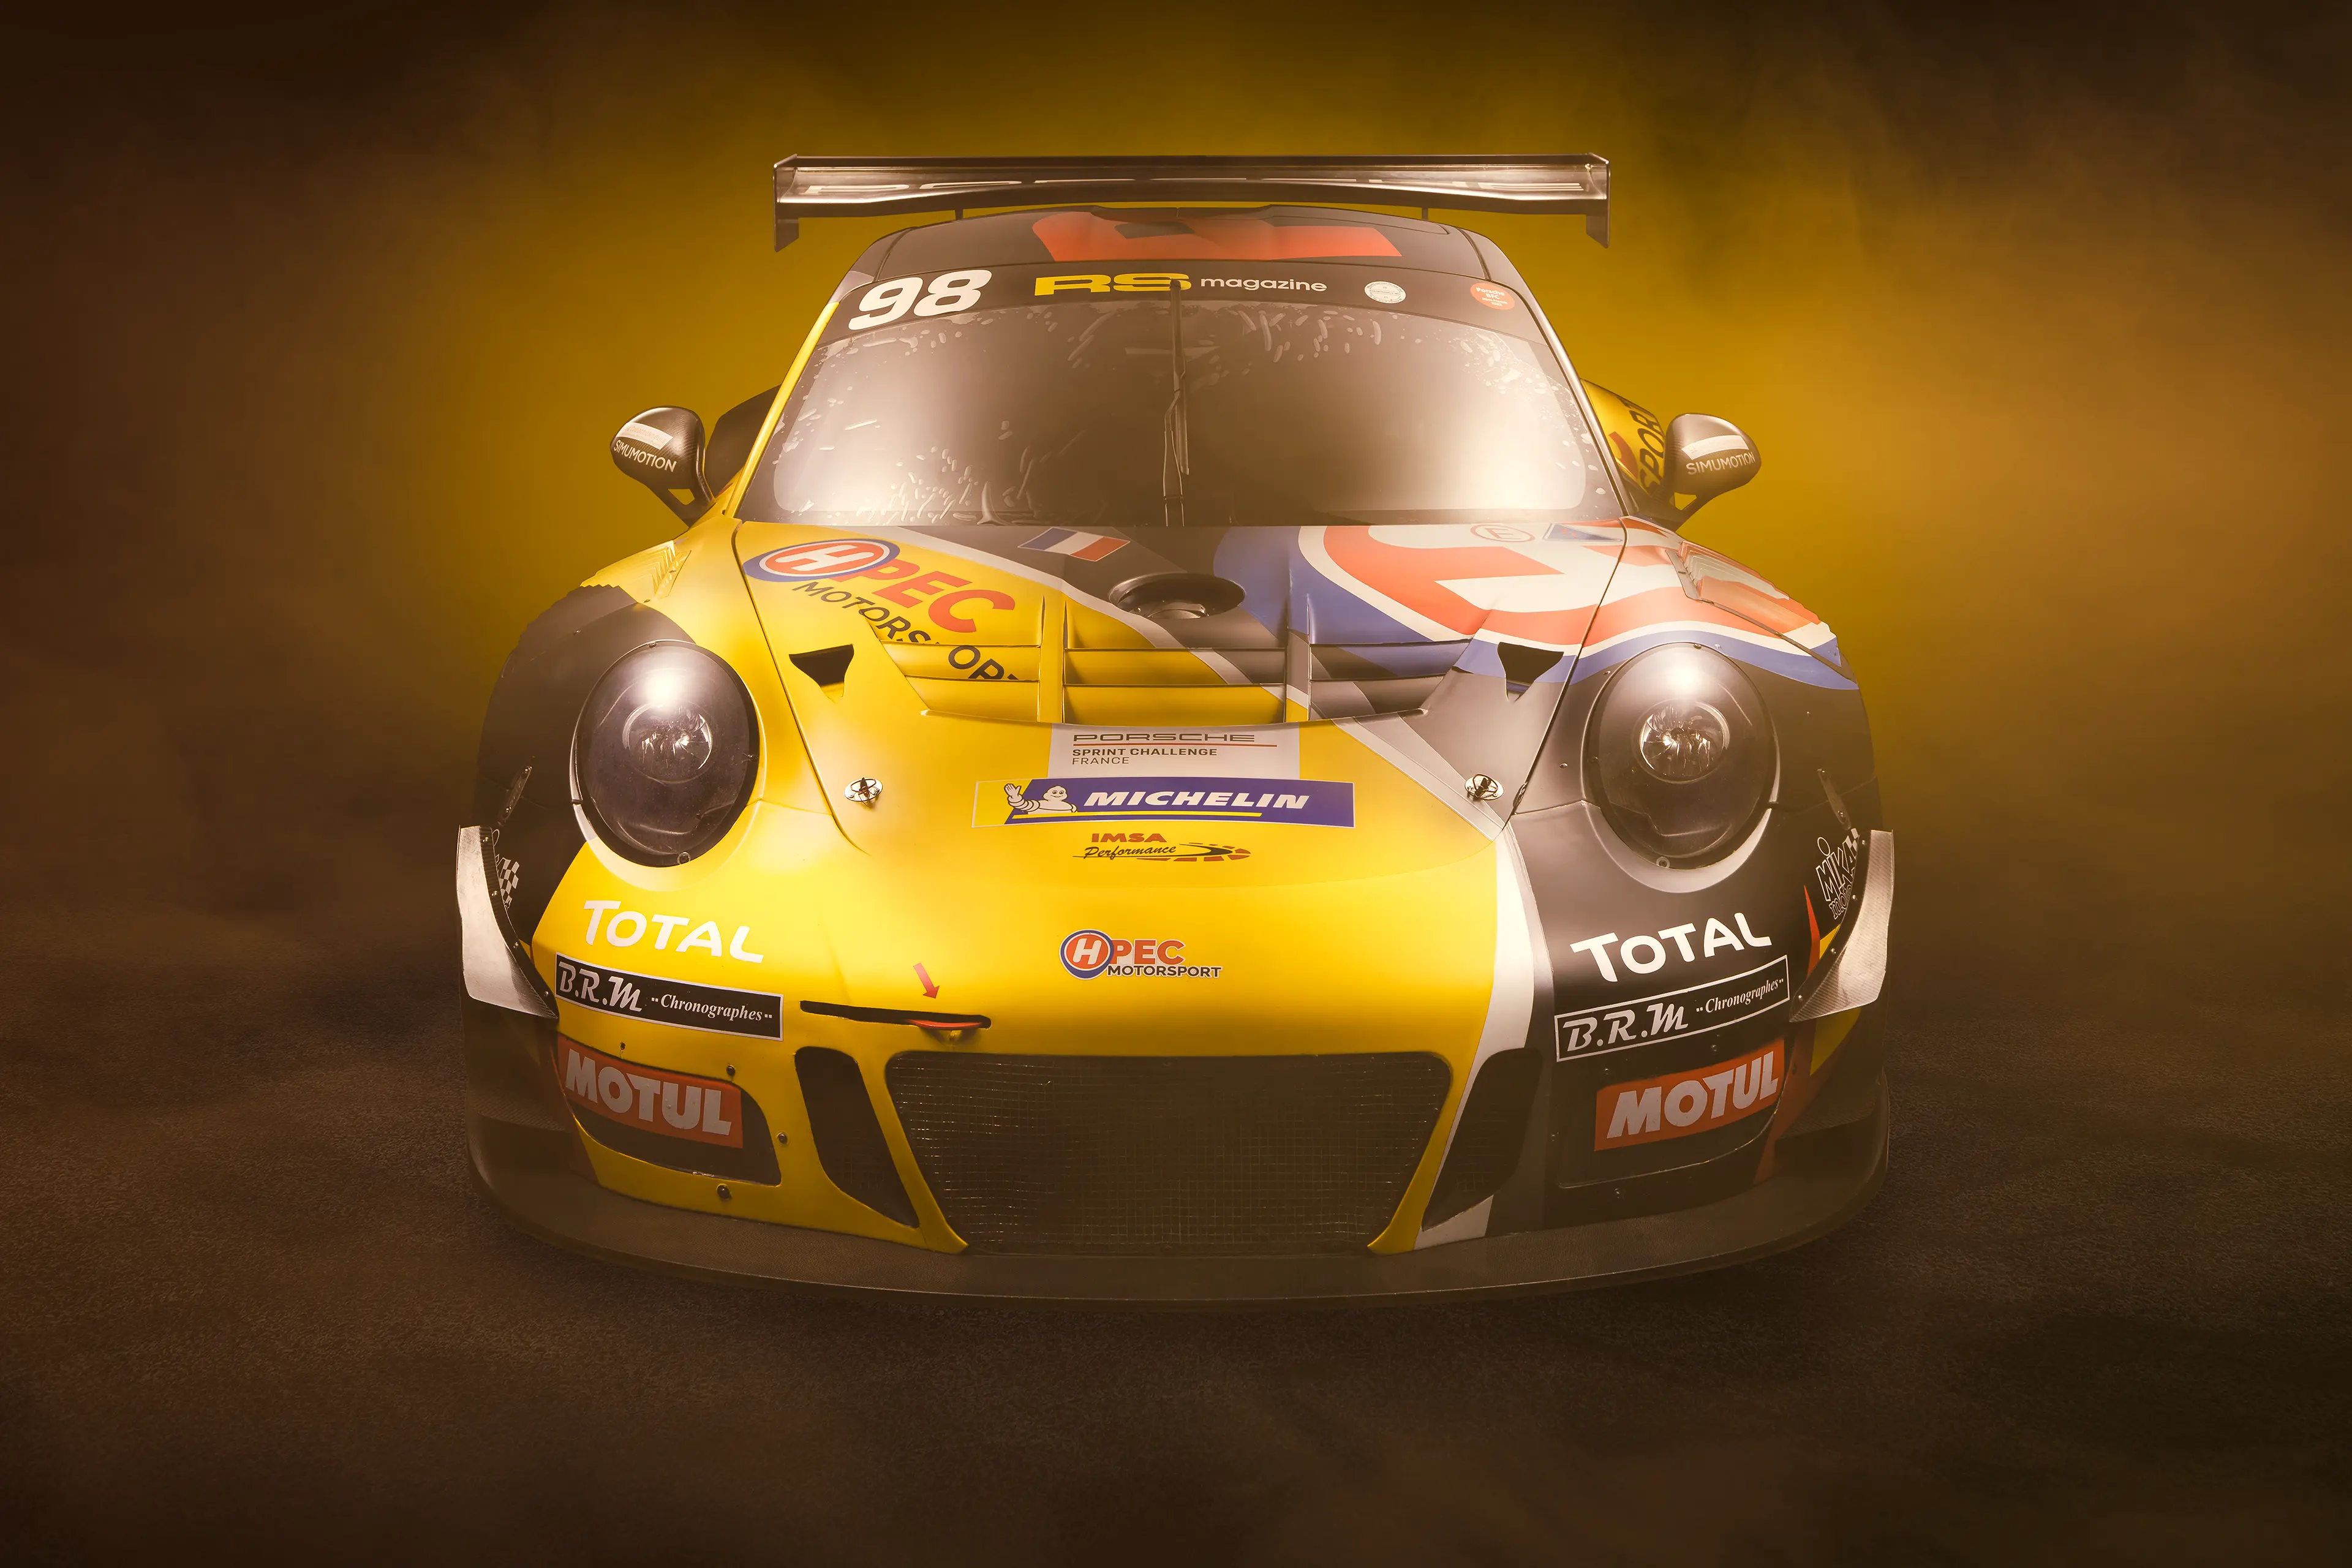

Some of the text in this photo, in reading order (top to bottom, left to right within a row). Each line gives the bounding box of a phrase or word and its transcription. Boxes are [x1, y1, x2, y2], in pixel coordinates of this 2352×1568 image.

[1035, 273, 1327, 296] RS magazine
[1476, 287, 1505, 296] Porsche
[848, 270, 992, 330] 98
[614, 439, 677, 472] SIMUMOTION
[1686, 451, 1756, 475] SIMUMOTION
[1072, 756, 1129, 765] FRANCE
[1084, 792, 1310, 809] MICHELIN
[1091, 833, 1167, 843] IMSA
[1083, 845, 1177, 860] Performance
[1107, 965, 1223, 978] MOTORSPORT
[565, 1049, 732, 1136] MOTUL
[1606, 1050, 1779, 1139] MOTUL
